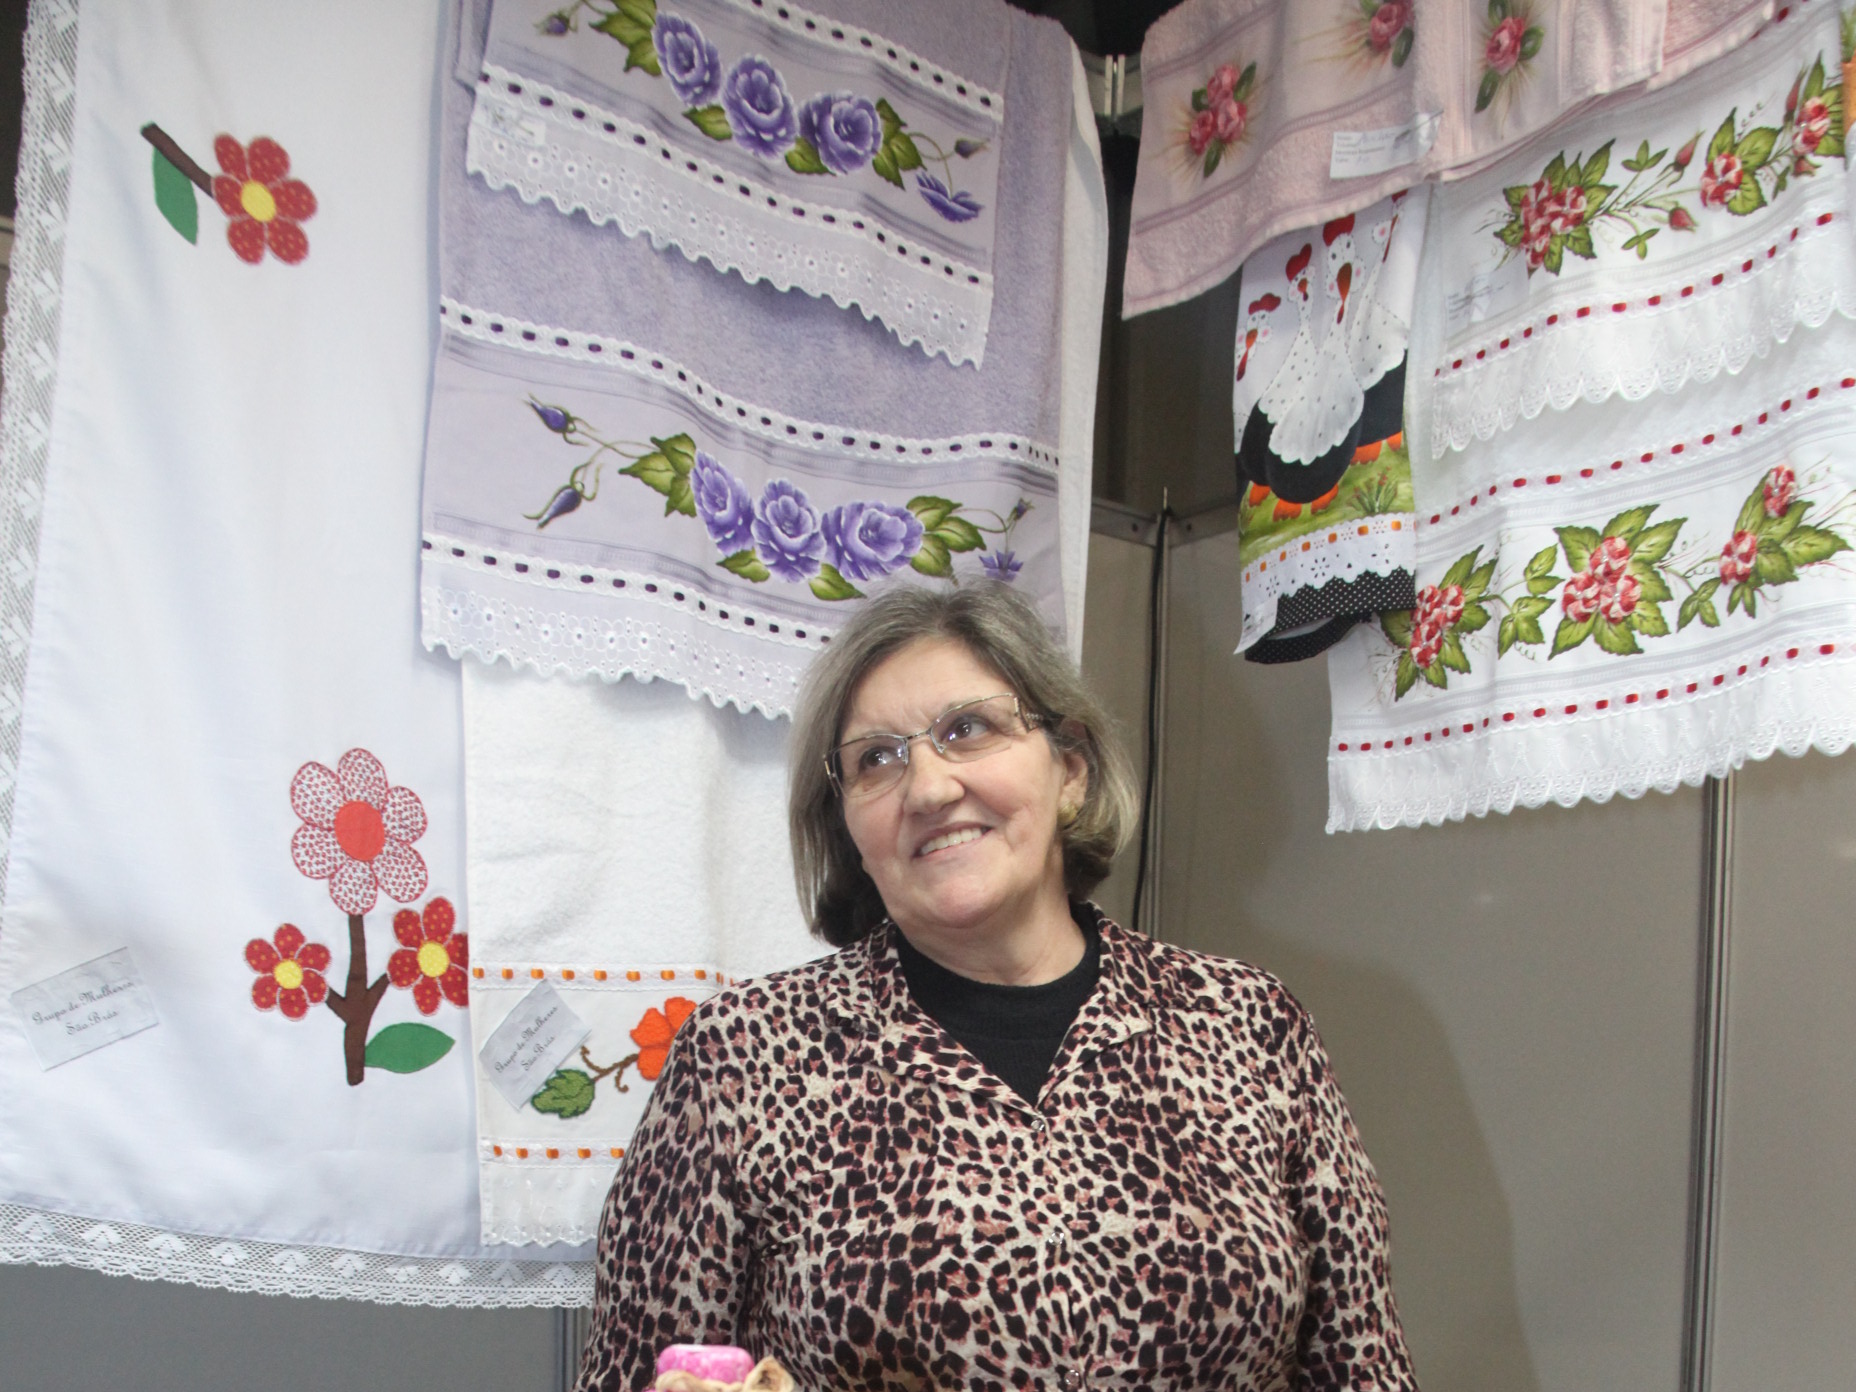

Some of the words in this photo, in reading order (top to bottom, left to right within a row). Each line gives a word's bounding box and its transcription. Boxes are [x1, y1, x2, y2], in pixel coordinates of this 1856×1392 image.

[32, 1009, 67, 1025] Grupo
[79, 981, 135, 1005] Mulheres
[65, 1022, 88, 1035] São
[494, 1051, 518, 1073] Grupo
[521, 1006, 558, 1041] Mulheres
[520, 1056, 538, 1072] São
